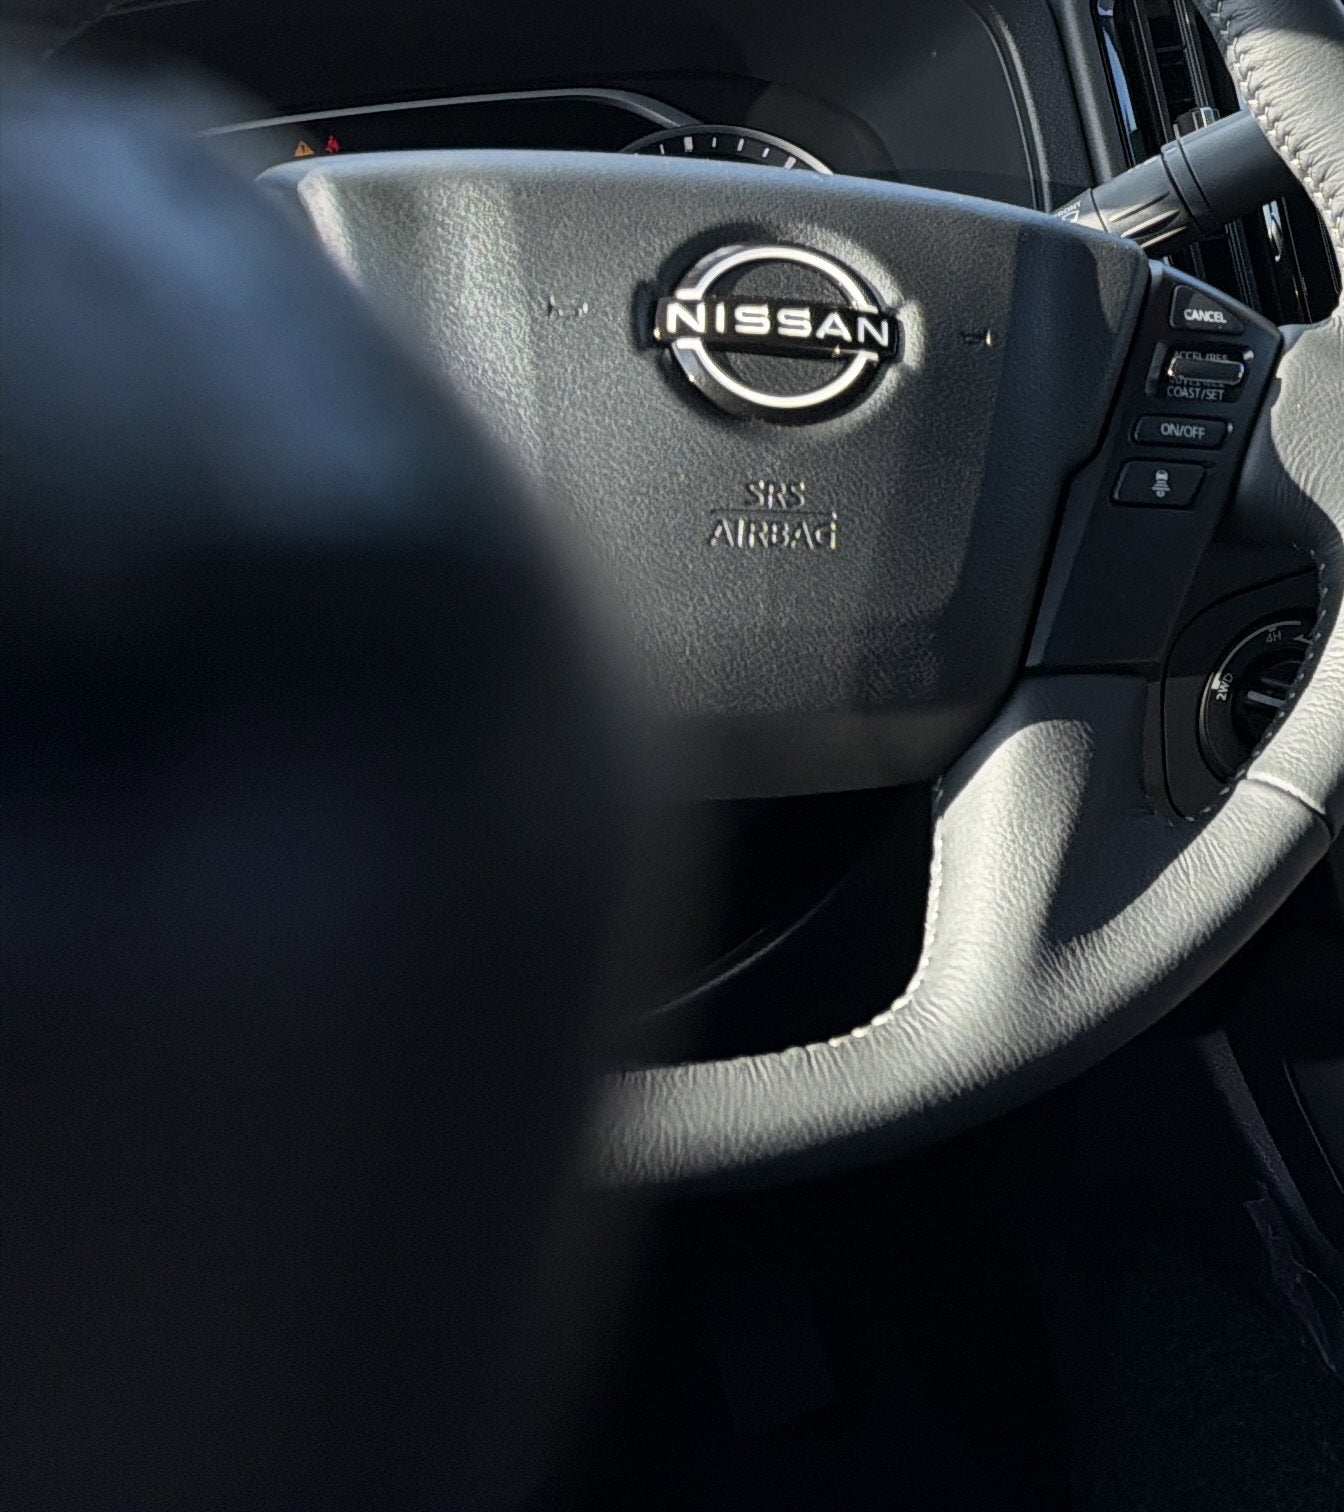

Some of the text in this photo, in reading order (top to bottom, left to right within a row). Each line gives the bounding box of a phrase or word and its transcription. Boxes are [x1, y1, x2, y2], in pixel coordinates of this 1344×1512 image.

[665, 300, 890, 350] NISSAN
[1184, 309, 1227, 324] CANCEL
[1167, 386, 1225, 401] COAST/SET
[1160, 423, 1205, 438] ON/OFF
[744, 480, 806, 510] SRS
[709, 515, 840, 553] AIRBAG
[1265, 630, 1282, 644] 4H
[1215, 672, 1235, 701] 2WD
